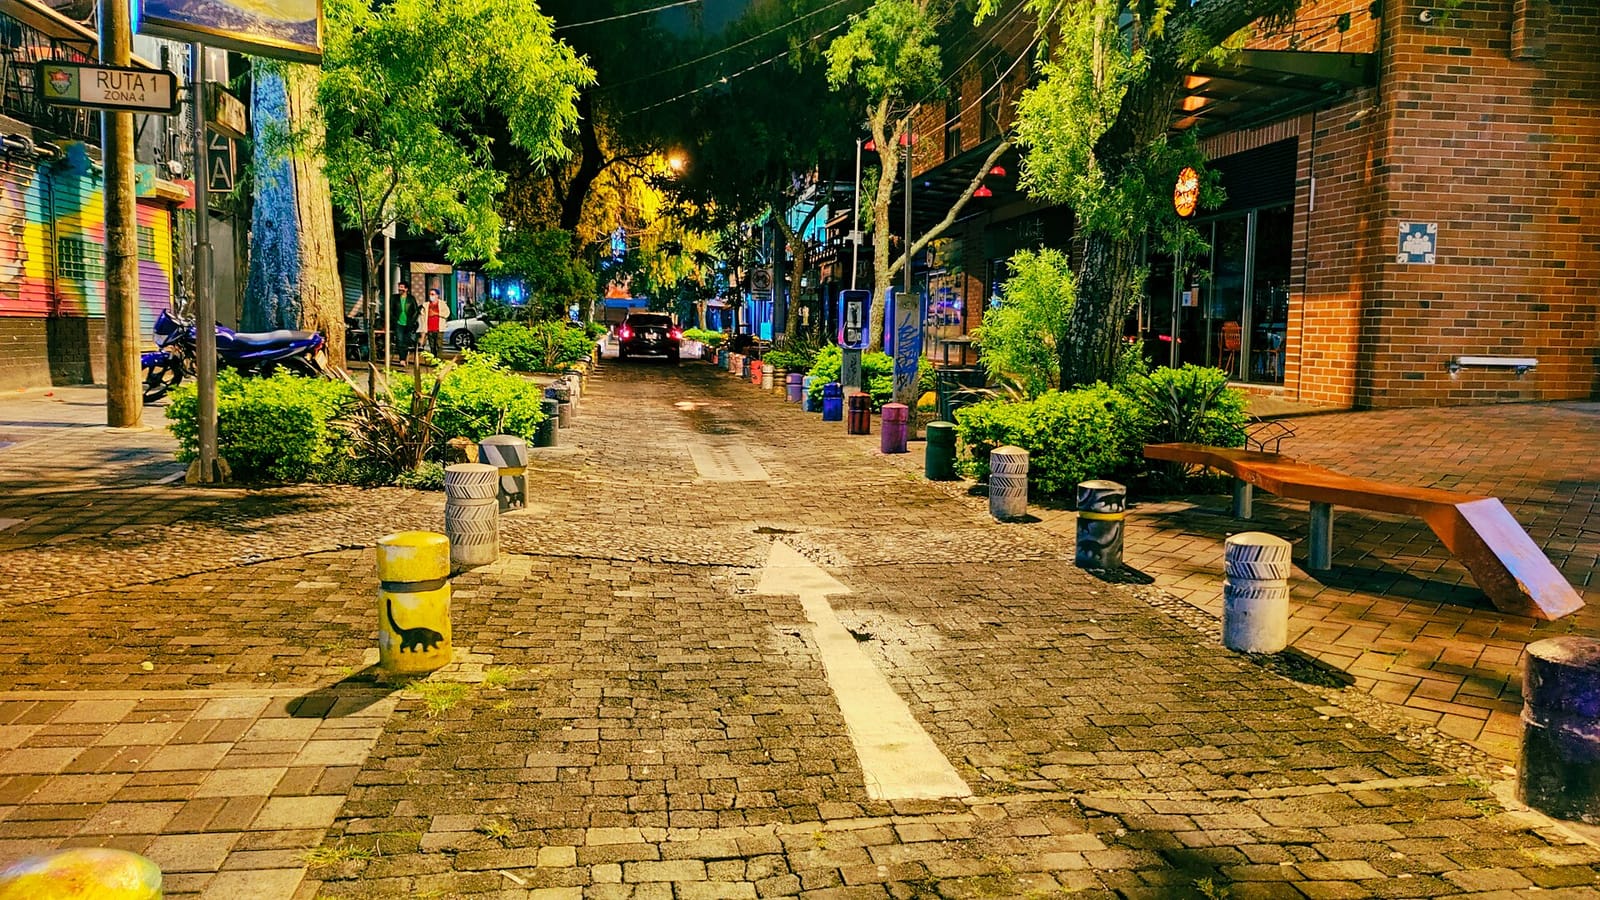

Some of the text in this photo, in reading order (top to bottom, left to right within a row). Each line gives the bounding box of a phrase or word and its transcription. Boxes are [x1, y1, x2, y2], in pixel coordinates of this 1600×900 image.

[97, 71, 157, 92] RUTA 1
[104, 90, 145, 102] ZONA 4
